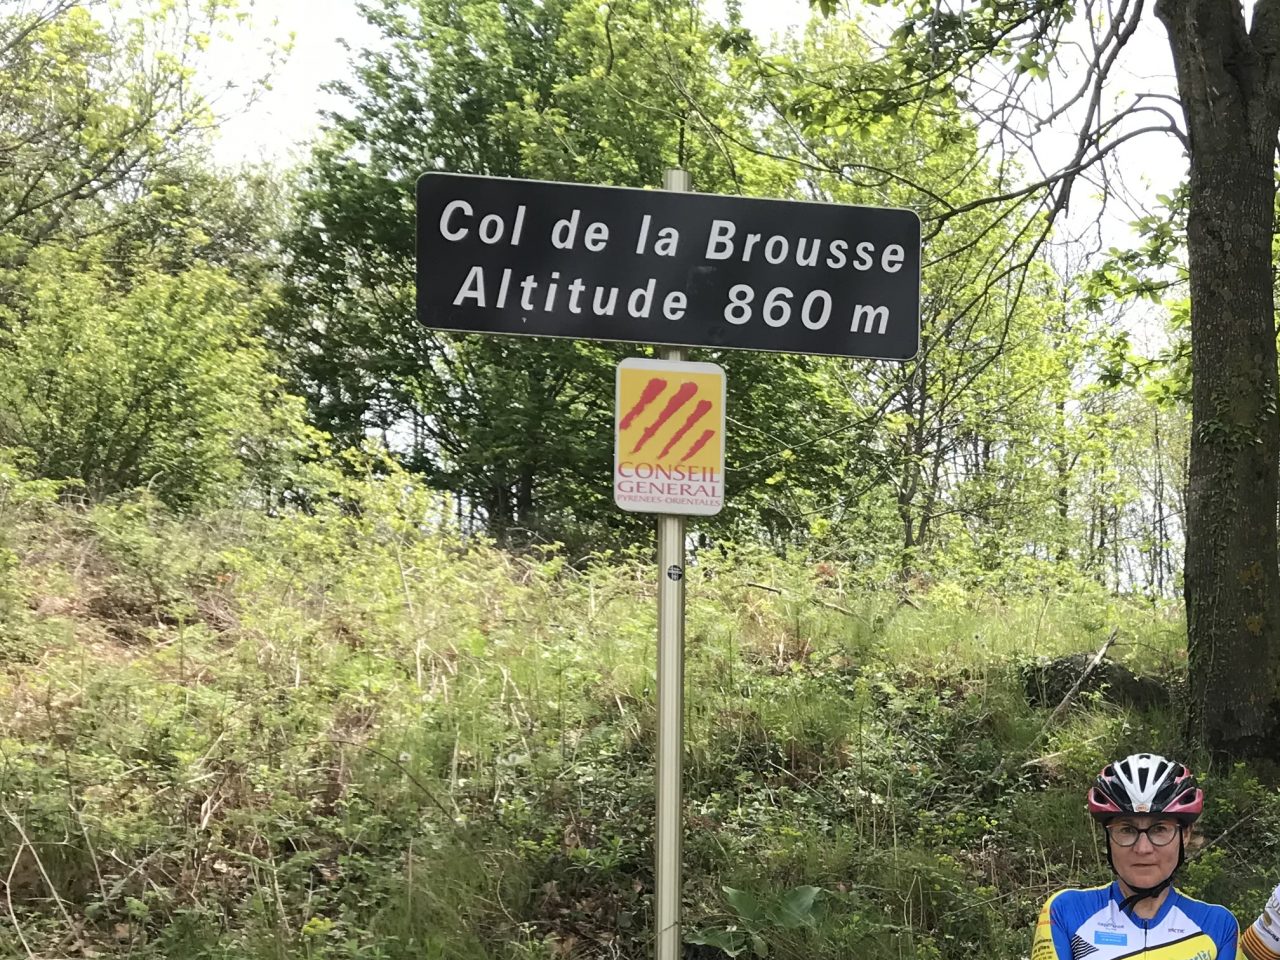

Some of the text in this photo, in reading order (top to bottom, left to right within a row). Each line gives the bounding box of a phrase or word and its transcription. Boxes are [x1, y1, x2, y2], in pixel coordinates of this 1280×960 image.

[438, 199, 906, 274] Col de la Brousse
[452, 265, 891, 336] Altitude 860 m
[617, 461, 720, 484] CONSEIL
[617, 480, 721, 498] GENERAL
